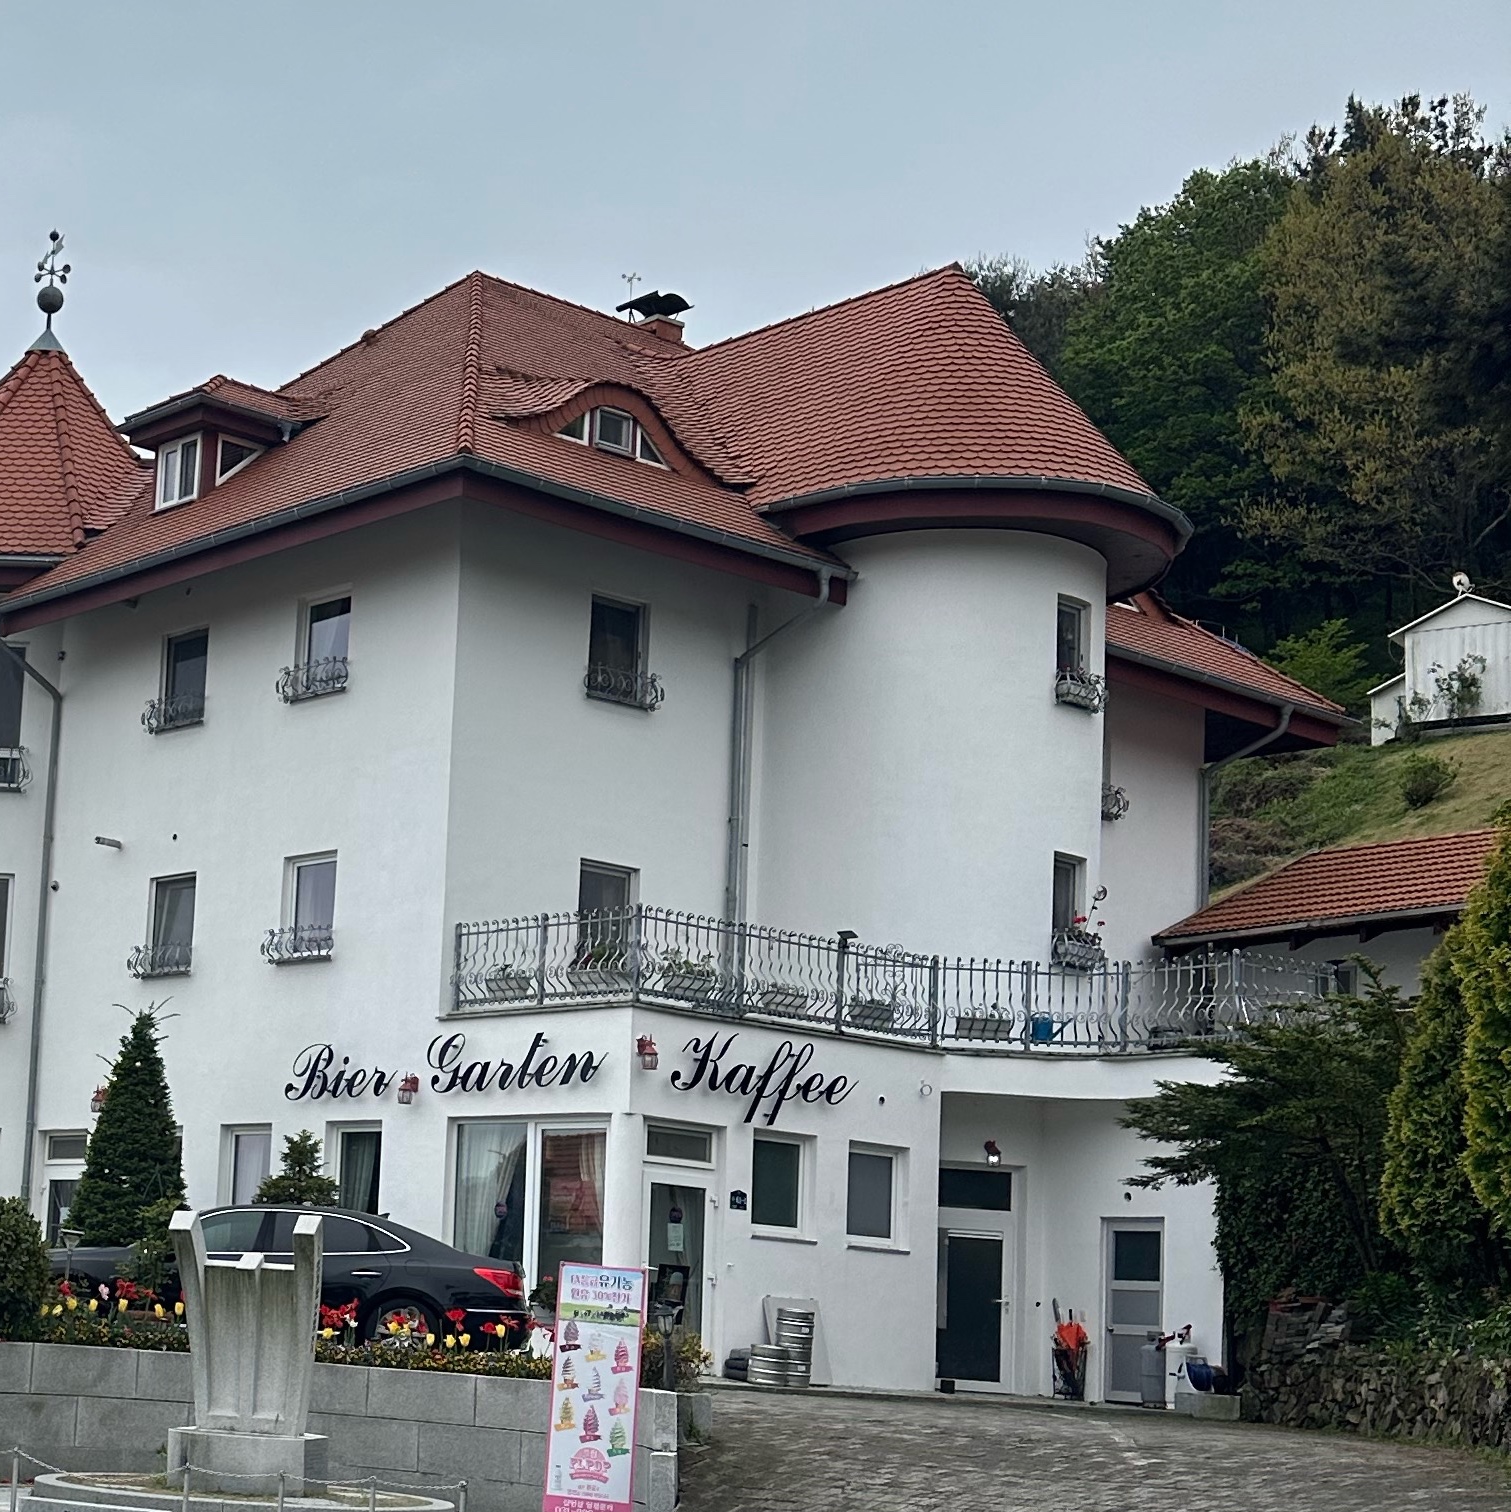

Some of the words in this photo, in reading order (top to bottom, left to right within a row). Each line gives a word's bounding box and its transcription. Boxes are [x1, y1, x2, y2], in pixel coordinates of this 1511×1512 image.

[285, 1042, 399, 1102] Bier
[426, 1031, 611, 1094] Garten
[670, 1031, 860, 1126] Kaffee
